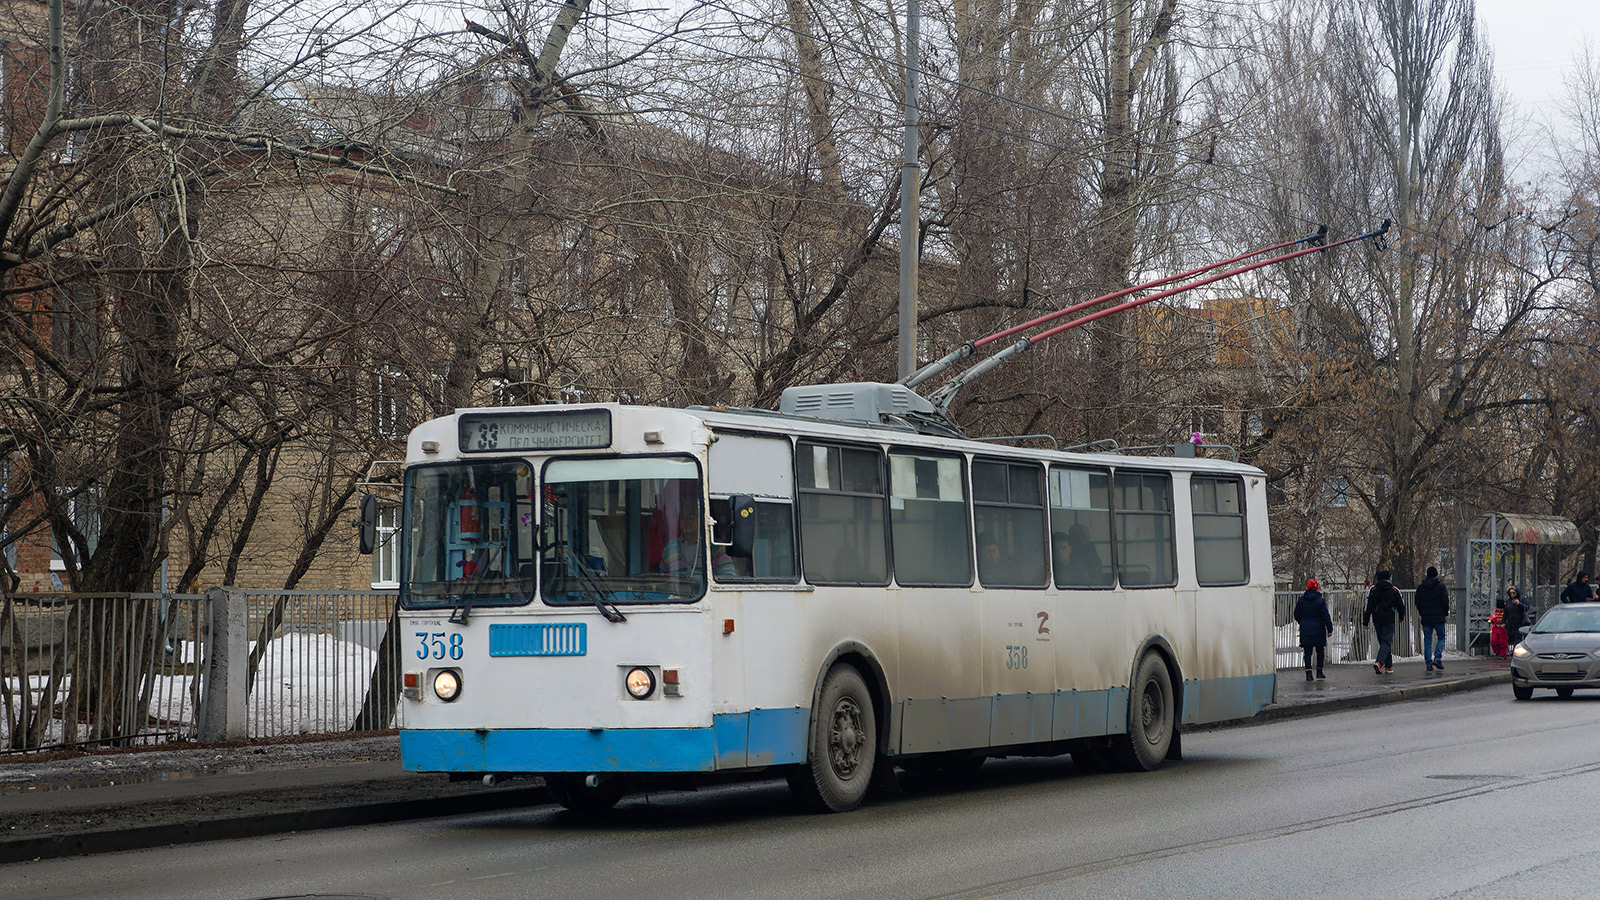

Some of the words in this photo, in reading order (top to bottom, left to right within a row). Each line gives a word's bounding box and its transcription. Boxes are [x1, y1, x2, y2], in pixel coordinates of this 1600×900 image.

[478, 423, 498, 449] 33
[500, 420, 608, 435] КОММУНИСТИЧЕСКАЯ
[415, 632, 463, 660] 358
[1005, 645, 1028, 670] 358
